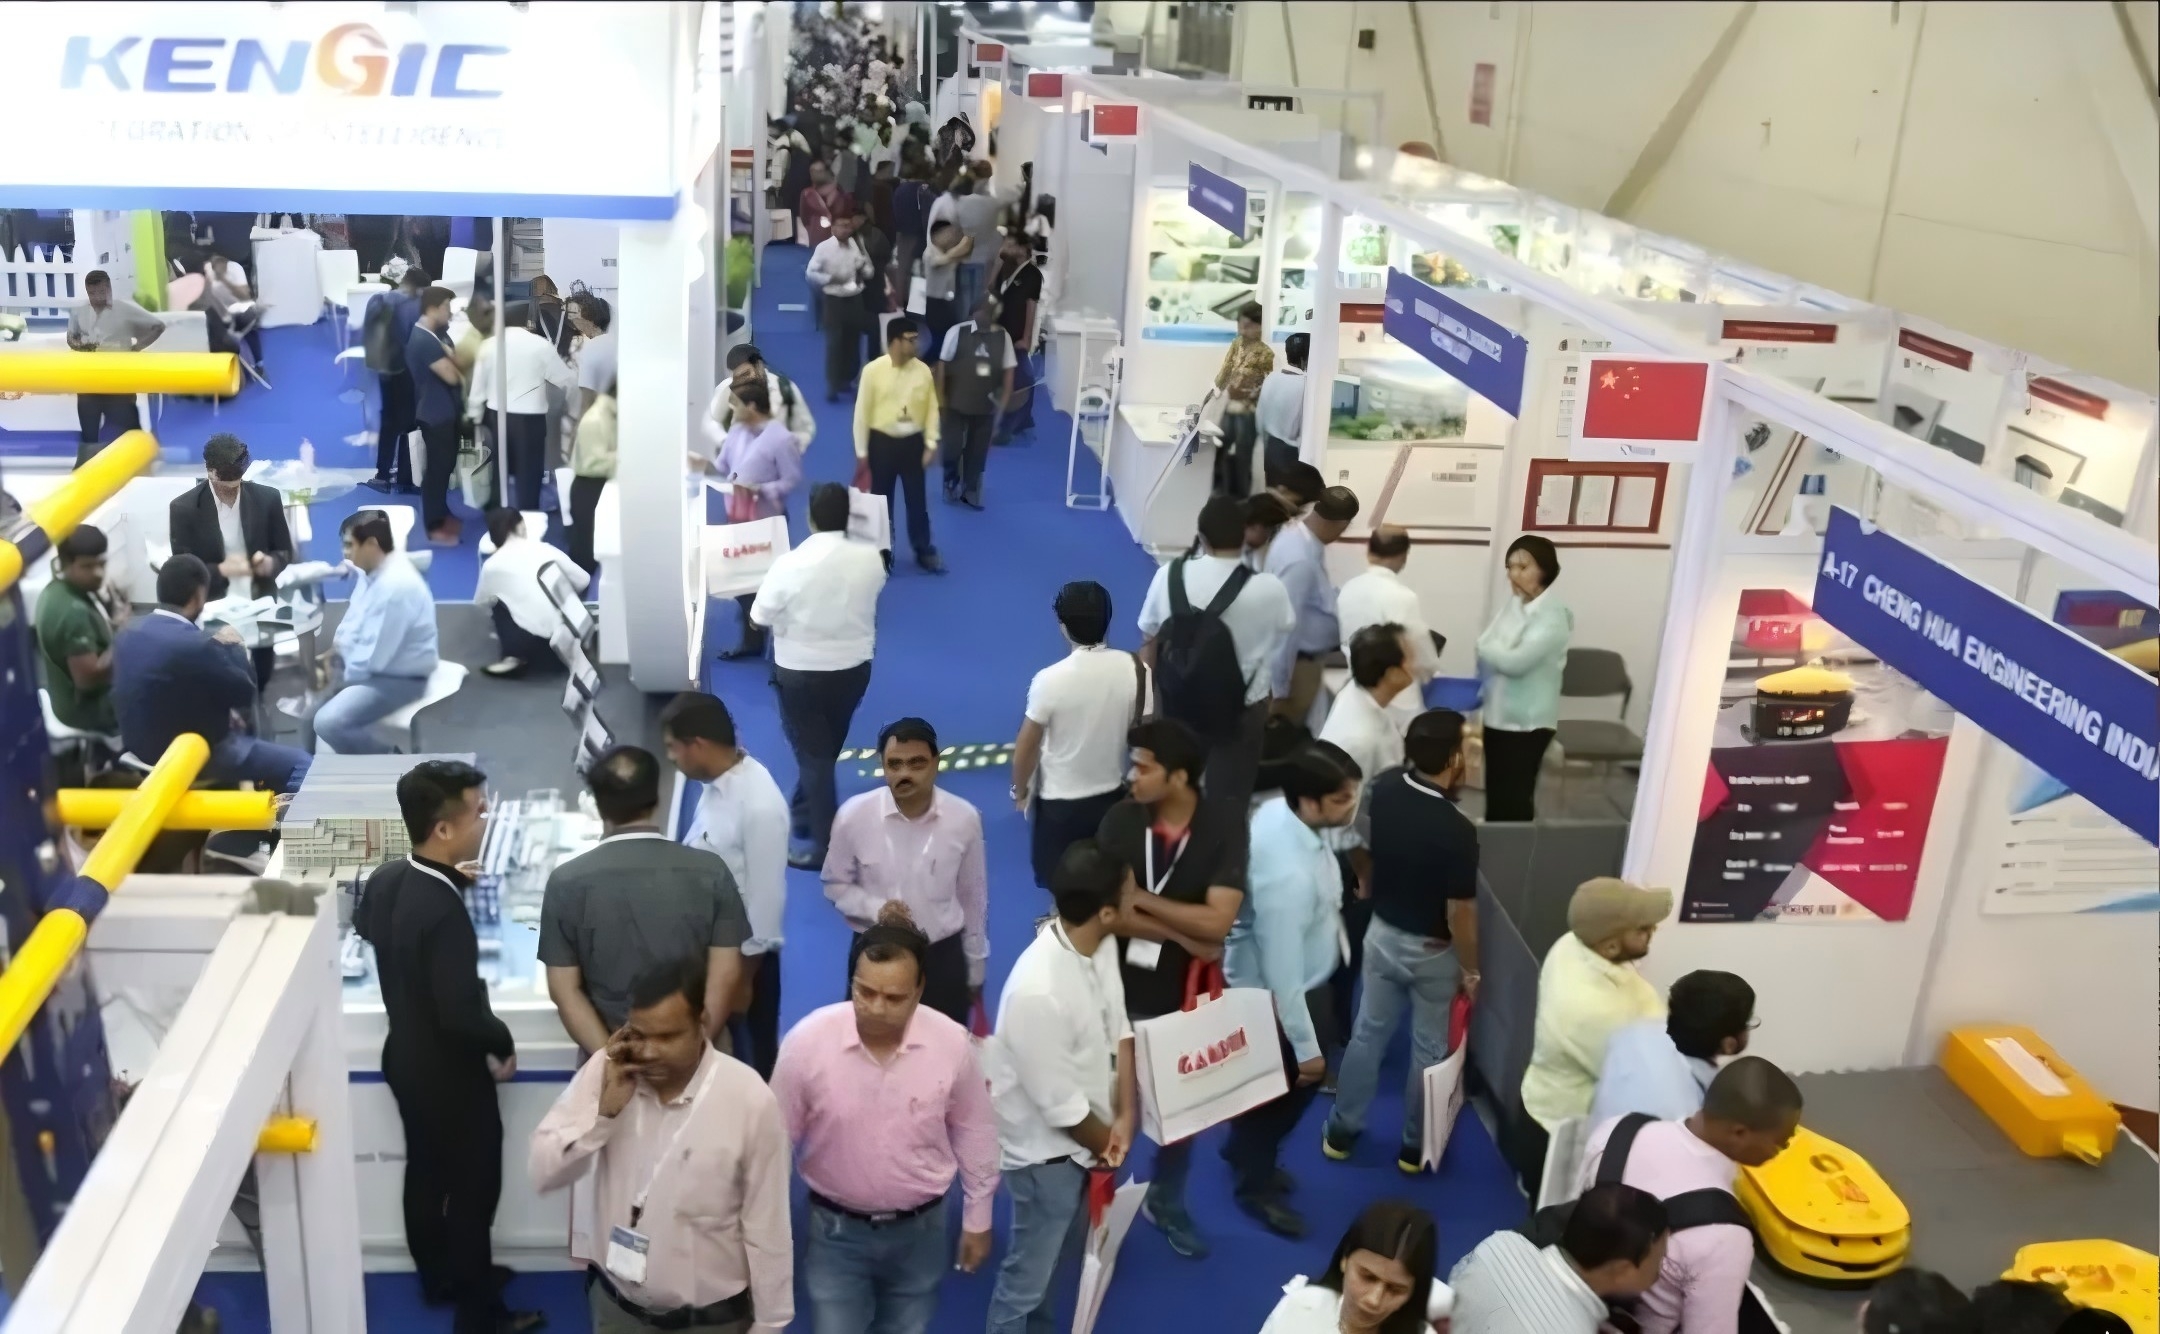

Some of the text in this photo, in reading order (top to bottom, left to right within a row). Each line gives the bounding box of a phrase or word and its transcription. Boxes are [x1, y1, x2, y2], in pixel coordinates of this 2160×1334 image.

[60, 22, 512, 99] KENGIC
[1822, 552, 1859, 588] A-17
[1863, 574, 1922, 631] CHENG
[1922, 610, 1961, 657] HUA
[1963, 635, 2103, 746] ENGINEERING
